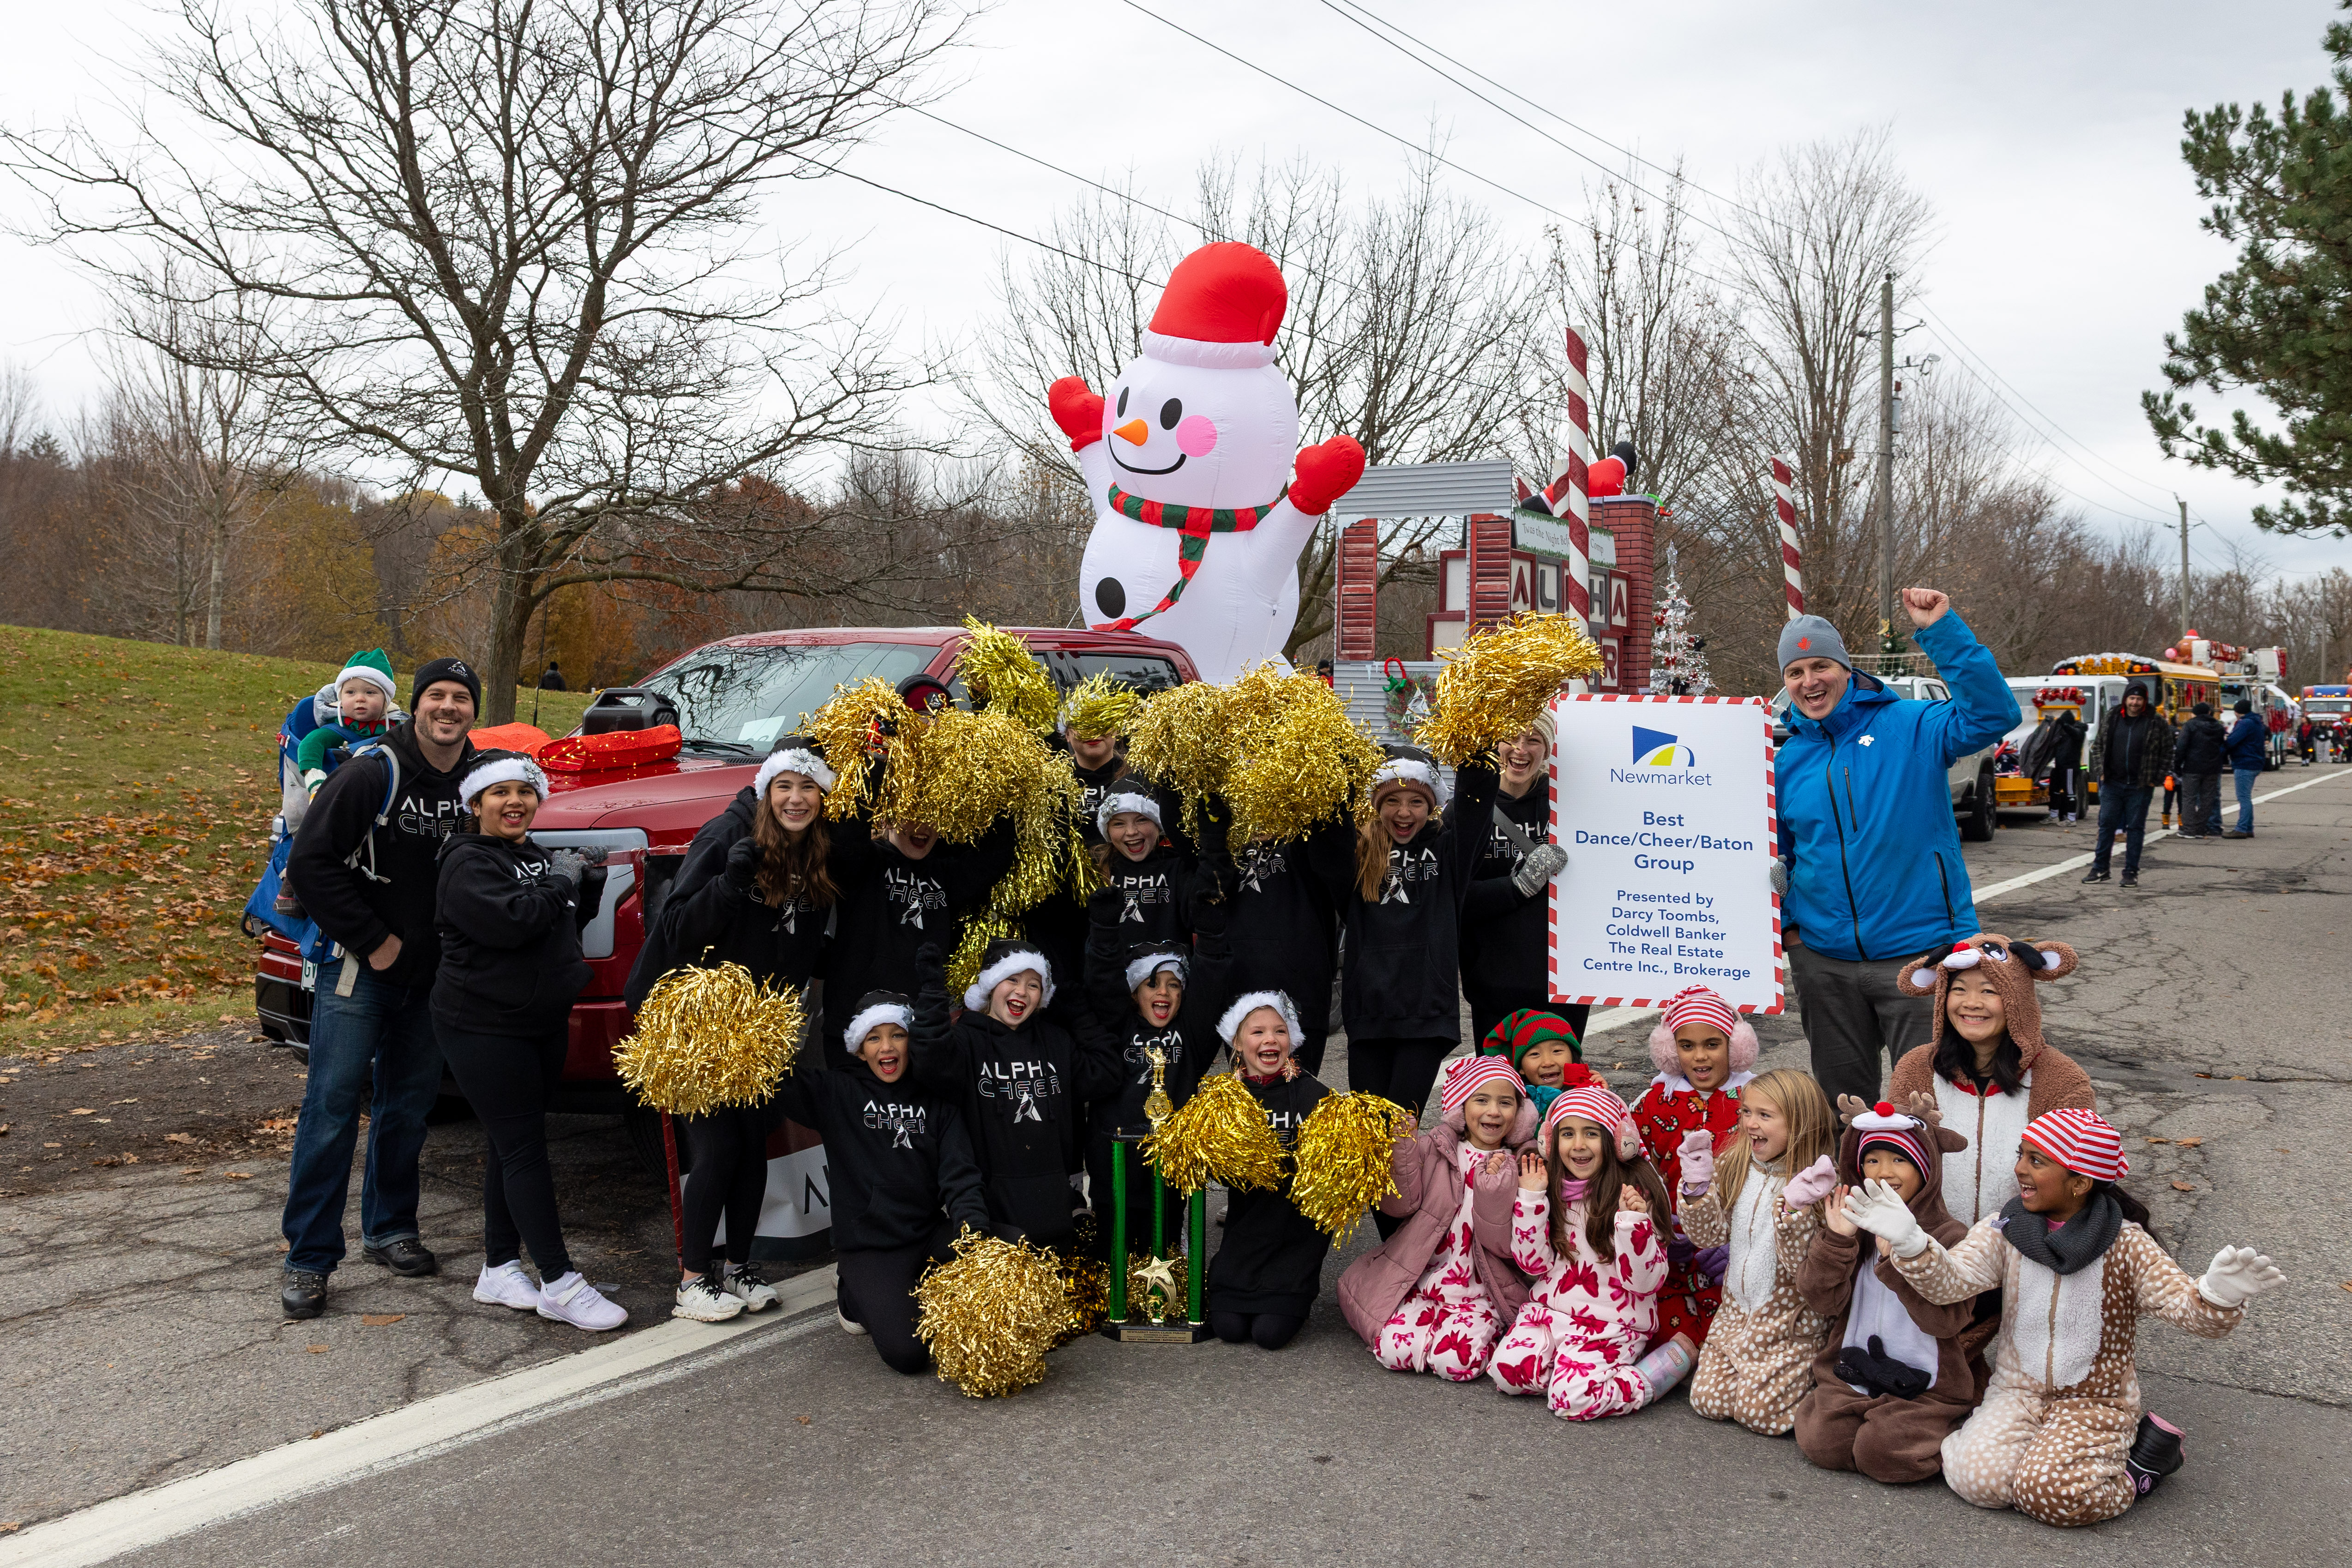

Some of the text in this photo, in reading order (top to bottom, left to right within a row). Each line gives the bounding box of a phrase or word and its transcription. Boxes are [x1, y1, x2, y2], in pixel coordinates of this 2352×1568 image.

[1522, 523, 1535, 535] Twas
[1536, 526, 1544, 538] the
[1546, 530, 1559, 547] Night
[1590, 538, 1604, 556] Comp
[1512, 565, 1626, 617] ALHA
[2112, 663, 2125, 673] BUS
[1610, 768, 1712, 786] Newmarket
[401, 795, 463, 818] ALPH
[1643, 811, 1684, 827] Best
[1576, 830, 1753, 851] Dance/Cheer/Baton
[1634, 854, 1695, 875] Group
[885, 885, 947, 909] HEER
[1123, 888, 1170, 903] EER
[1617, 889, 1714, 908] Presented by
[1612, 907, 1720, 925] Darcy Toombs,
[1606, 924, 1727, 941] Coldwell Banker
[1608, 942, 1724, 958] The Real Estate
[1583, 958, 1751, 981] Centre Inc., Brokerage
